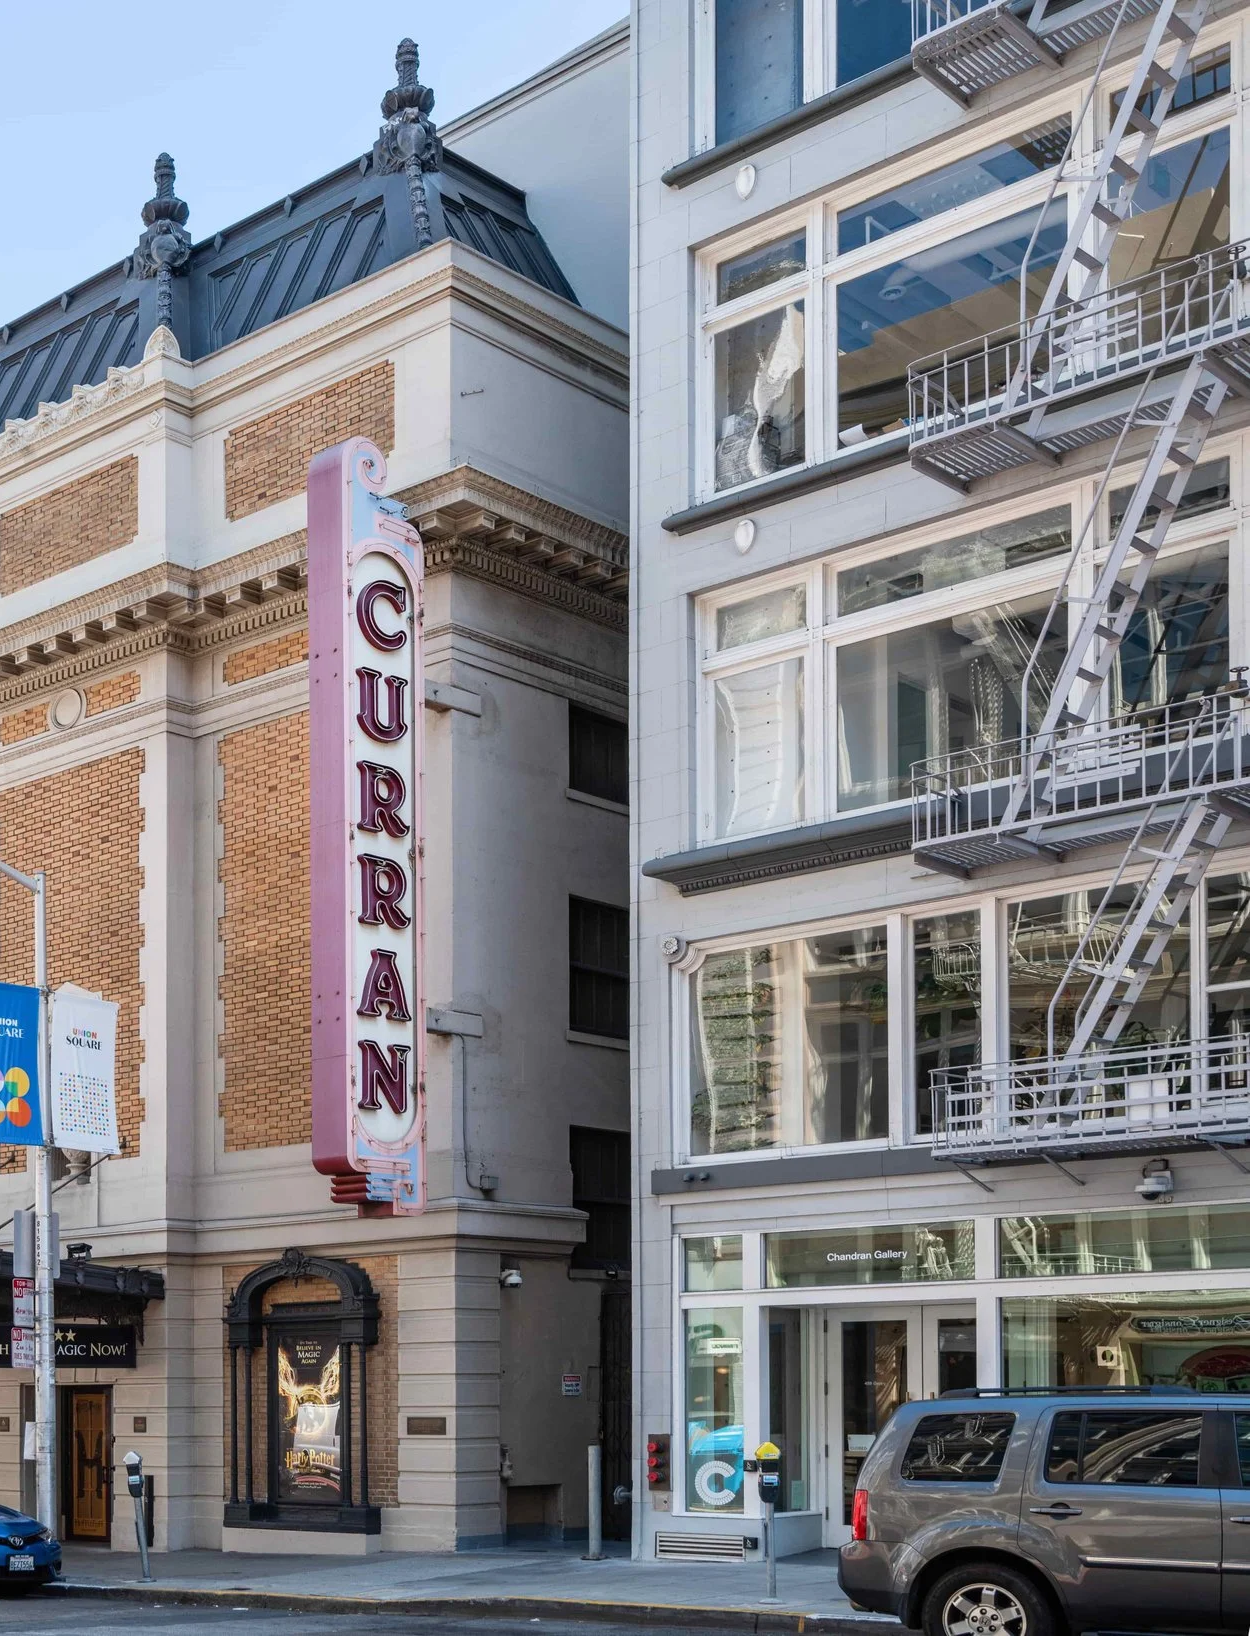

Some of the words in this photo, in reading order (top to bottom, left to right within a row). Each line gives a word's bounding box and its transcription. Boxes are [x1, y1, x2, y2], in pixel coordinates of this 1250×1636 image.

[355, 578, 412, 1116] CURRAN
[72, 1027, 98, 1039] UNION
[65, 1035, 102, 1051] SQUARE
[827, 1251, 872, 1262] Chandran
[874, 1249, 908, 1262] Gallery
[14, 1287, 22, 1297] NO
[13, 1329, 21, 1340] NO
[55, 1344, 87, 1356] AGIC
[297, 1350, 321, 1359] MAGIC
[284, 1449, 309, 1470] Harry
[309, 1448, 335, 1467] Potter
